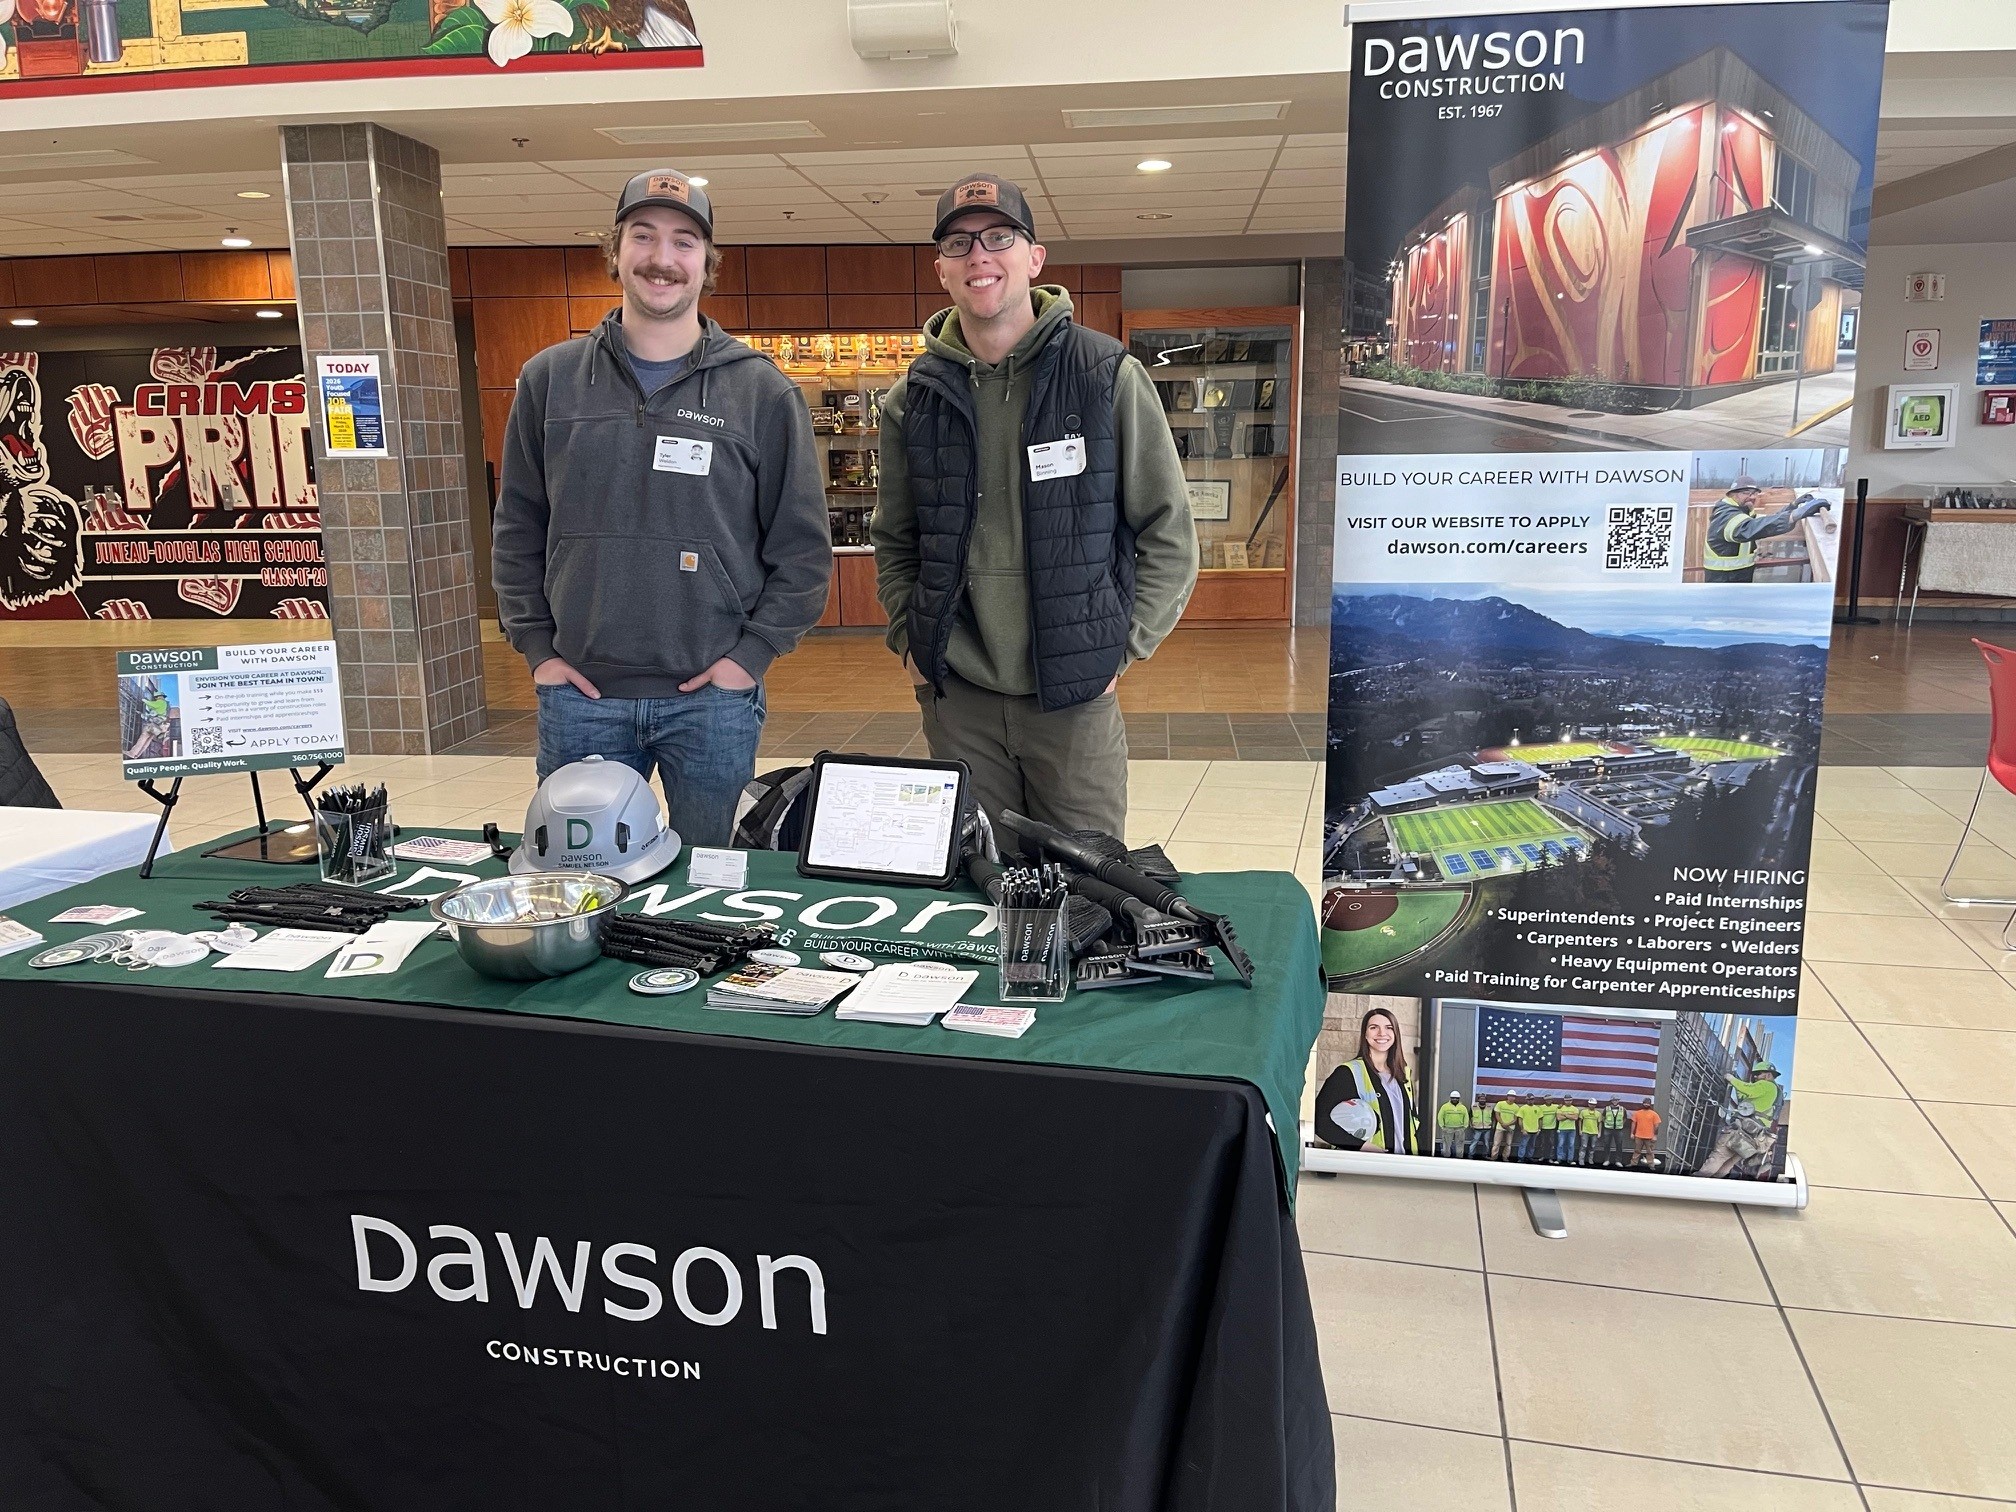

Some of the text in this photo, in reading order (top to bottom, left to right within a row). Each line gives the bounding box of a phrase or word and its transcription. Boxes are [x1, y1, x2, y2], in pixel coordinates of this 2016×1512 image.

[1364, 27, 1585, 77] Dawson
[1379, 72, 1565, 100] CONSTRUCTION
[1438, 104, 1503, 120] EST. 1967
[327, 363, 370, 373] TODAY
[676, 408, 725, 428] Dawson
[1912, 414, 1931, 422] AED
[1340, 468, 1685, 487] BUILD YOUR CAREER WITH DAWSON
[1347, 515, 1591, 529] VISIT OUR WEBSITE TO APPLY
[95, 540, 221, 564] JUNEAU-DOUGLAS
[225, 540, 261, 563] HIGH
[1387, 538, 1588, 555] dawson.com/careers
[261, 567, 296, 587] CLASS
[296, 567, 311, 587] OF
[129, 649, 203, 666] Dawson
[225, 645, 330, 658] BUILD YOUR CAREER
[240, 654, 316, 665] WITH DAWSON
[135, 662, 199, 671] CONSTRUCTION
[197, 681, 217, 689] JOIN
[219, 680, 236, 688] THE
[260, 678, 284, 686] TEAM
[296, 676, 325, 684] TOWN!
[247, 691, 269, 699] training
[215, 700, 250, 709] Opportunity
[249, 705, 269, 713] variety
[276, 702, 311, 710] construction
[229, 714, 263, 722] internships
[275, 710, 319, 719] apprenticeships
[250, 733, 339, 749] APPLY TODAY!
[126, 750, 343, 776] Quality People. Quality Work. 360.756.1000
[566, 818, 594, 850] D
[560, 853, 603, 863] Dawson
[1673, 866, 1806, 885] NOW HIRING
[1665, 892, 1804, 913] Paid Internships
[1497, 907, 1802, 934] Superintendents Project Engineers
[803, 938, 839, 950] BUILD
[840, 940, 872, 953] YOUR
[874, 942, 919, 957] CAREER
[1022, 923, 1034, 962] Dawson
[1527, 931, 1800, 955] Carpenters Laborers Welders
[162, 947, 206, 960] Dawson
[898, 970, 909, 978] D
[1560, 954, 1798, 978] Heavy Equipment Operators
[1435, 969, 1796, 1002] Paid Training for Carpenter Apprenticeships
[350, 1214, 827, 1335] Dawson
[486, 1339, 701, 1380] CONSTRUCTION
